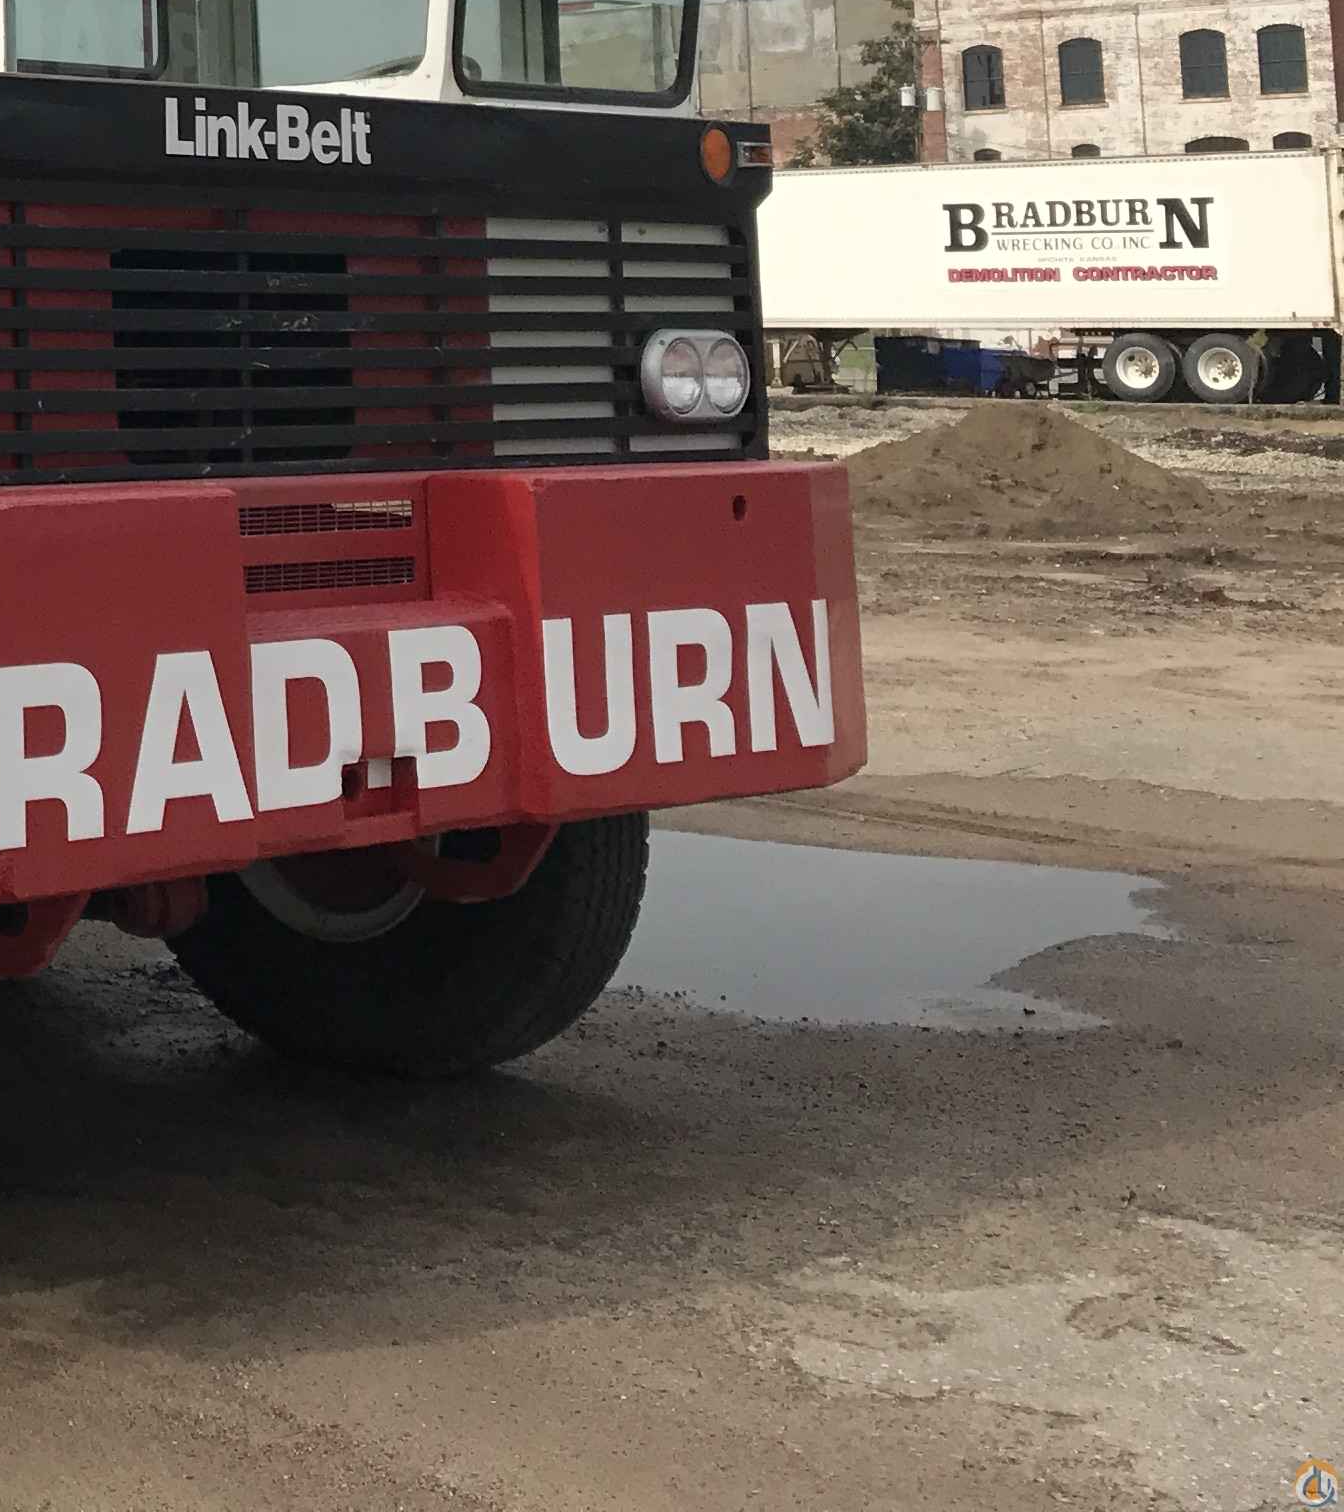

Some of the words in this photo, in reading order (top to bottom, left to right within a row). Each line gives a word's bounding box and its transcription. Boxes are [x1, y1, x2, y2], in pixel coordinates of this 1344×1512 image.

[164, 96, 372, 165] Link-Belt
[942, 197, 1214, 252] BRADBURN
[996, 237, 1084, 251] WRECKING
[947, 267, 1062, 283] DEMOLITION
[1072, 264, 1219, 282] CONTRACTOR
